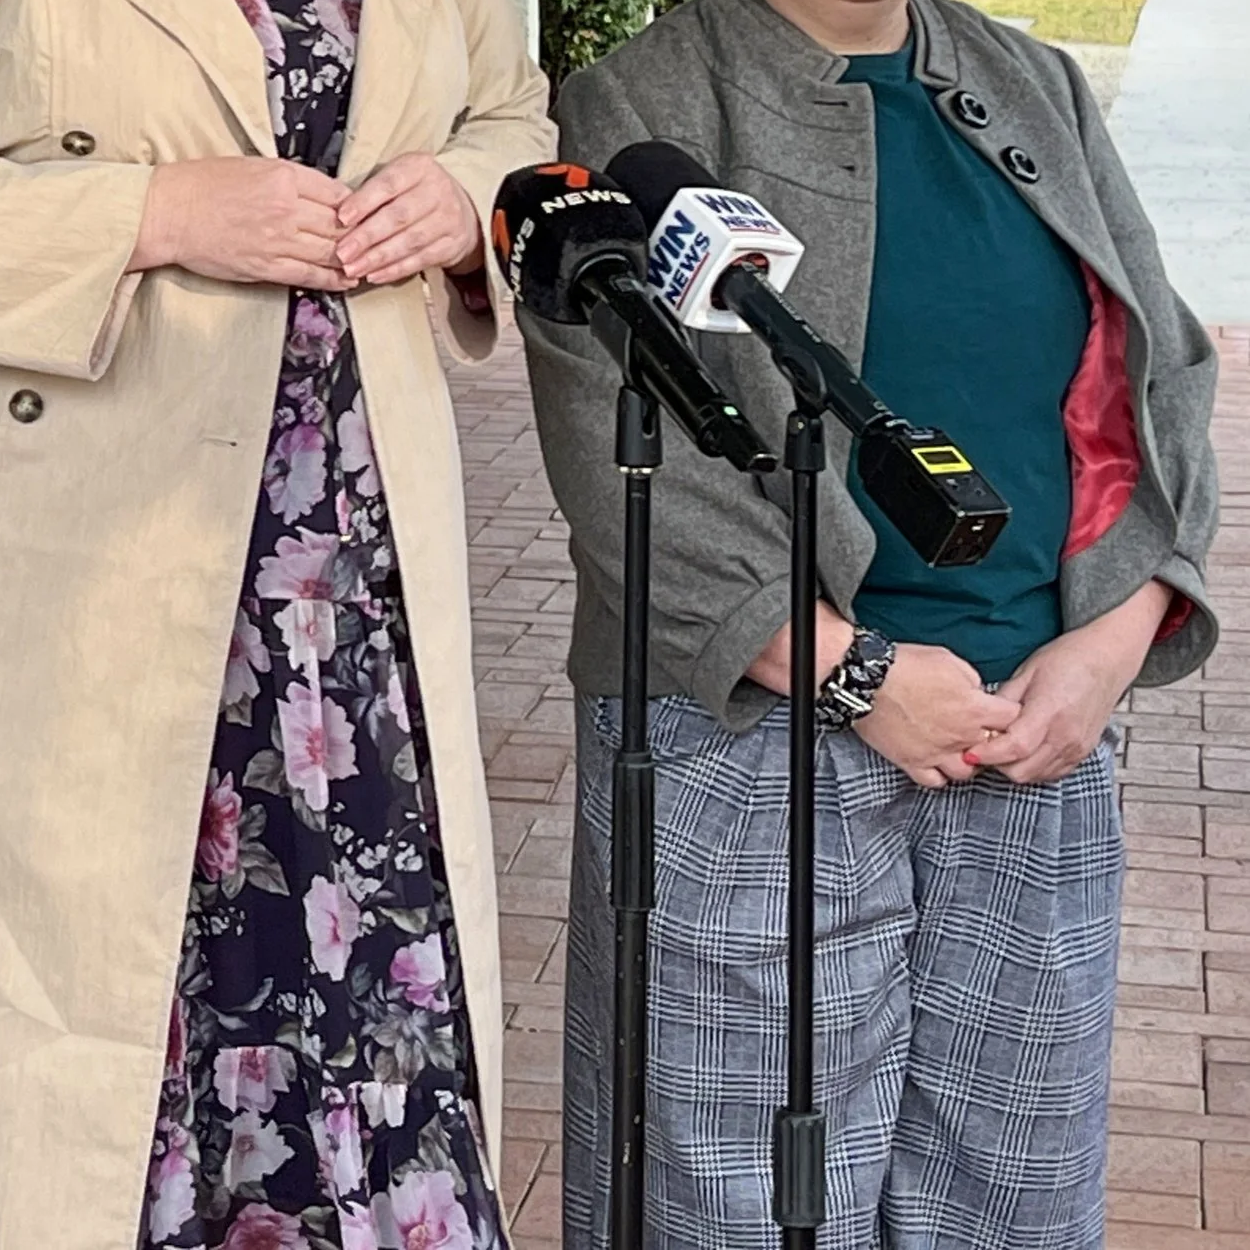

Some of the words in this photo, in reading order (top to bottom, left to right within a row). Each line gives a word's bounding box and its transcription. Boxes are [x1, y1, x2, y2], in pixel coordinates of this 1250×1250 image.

[540, 189, 632, 215] NEWS
[694, 193, 766, 219] WIN
[647, 209, 696, 290] WIN
[664, 231, 711, 306] NEWS
